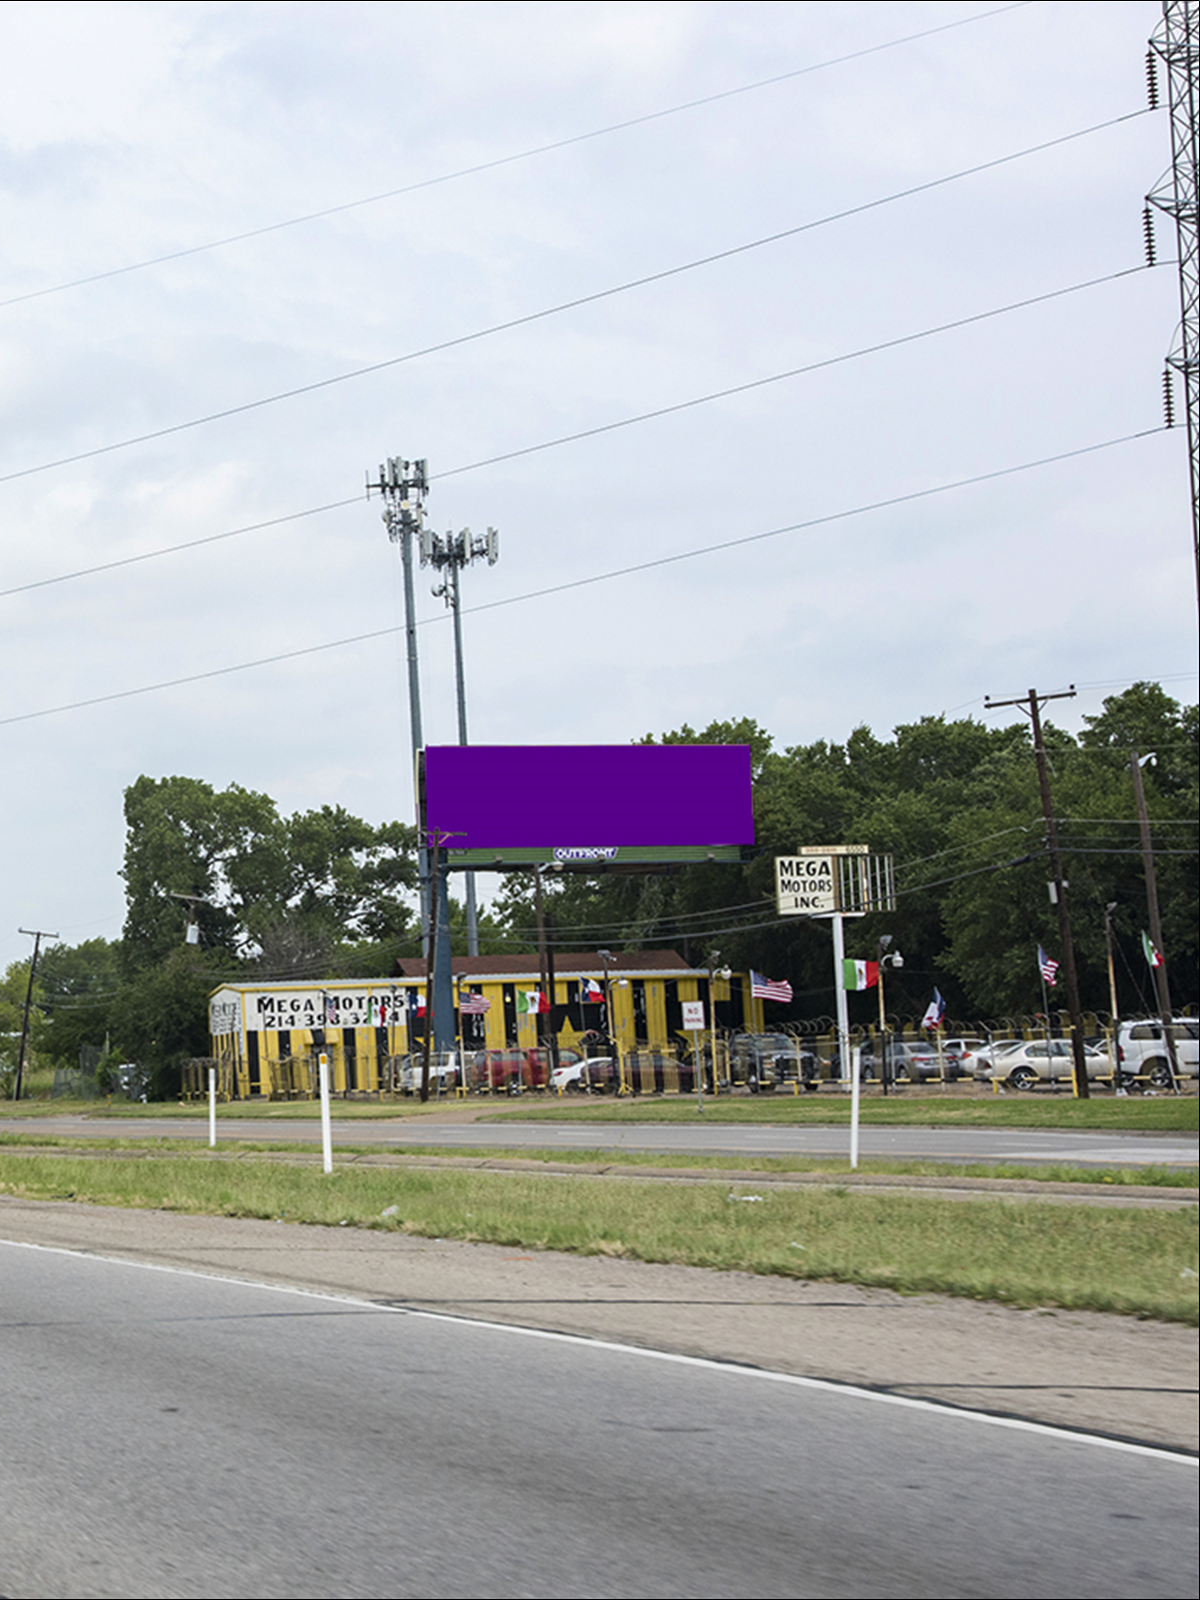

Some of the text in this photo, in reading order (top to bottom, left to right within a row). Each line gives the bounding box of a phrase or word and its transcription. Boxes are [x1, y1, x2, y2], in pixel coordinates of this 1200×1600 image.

[780, 860, 831, 877] MEGA
[781, 879, 833, 893] MOTORS
[794, 896, 825, 909] INC.
[257, 997, 315, 1014] MEGA
